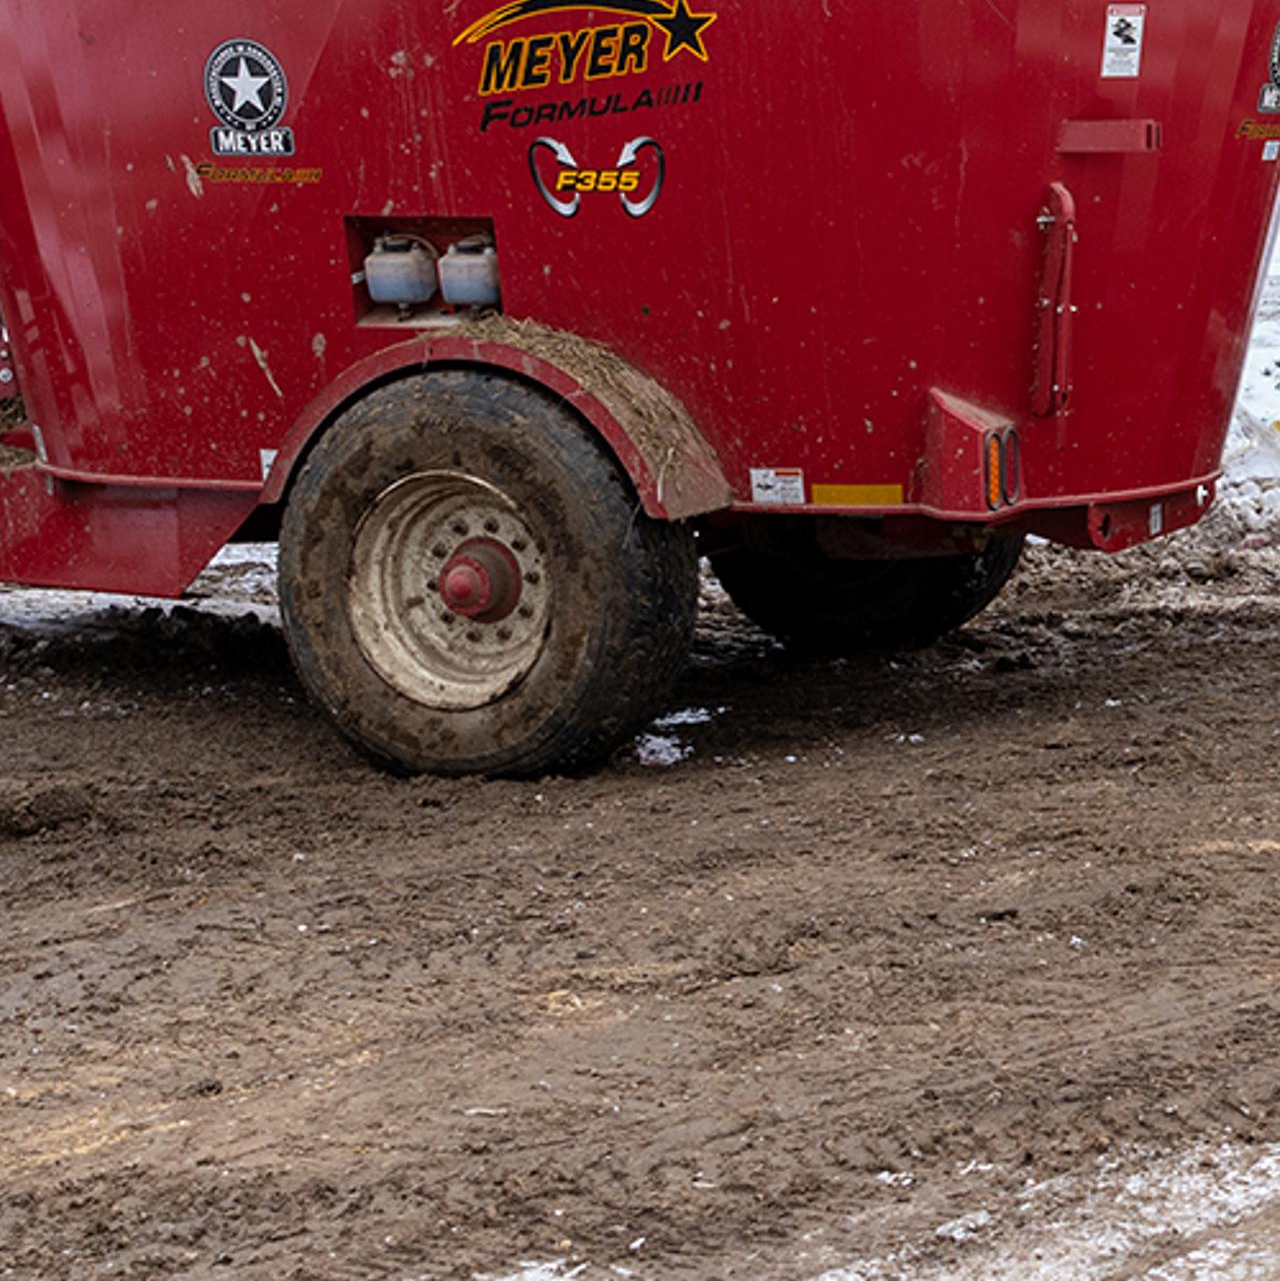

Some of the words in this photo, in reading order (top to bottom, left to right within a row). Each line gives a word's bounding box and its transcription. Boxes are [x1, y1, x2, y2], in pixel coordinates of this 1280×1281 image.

[478, 20, 652, 96] MEYER
[218, 130, 285, 152] MEYER
[556, 170, 641, 192] F355
